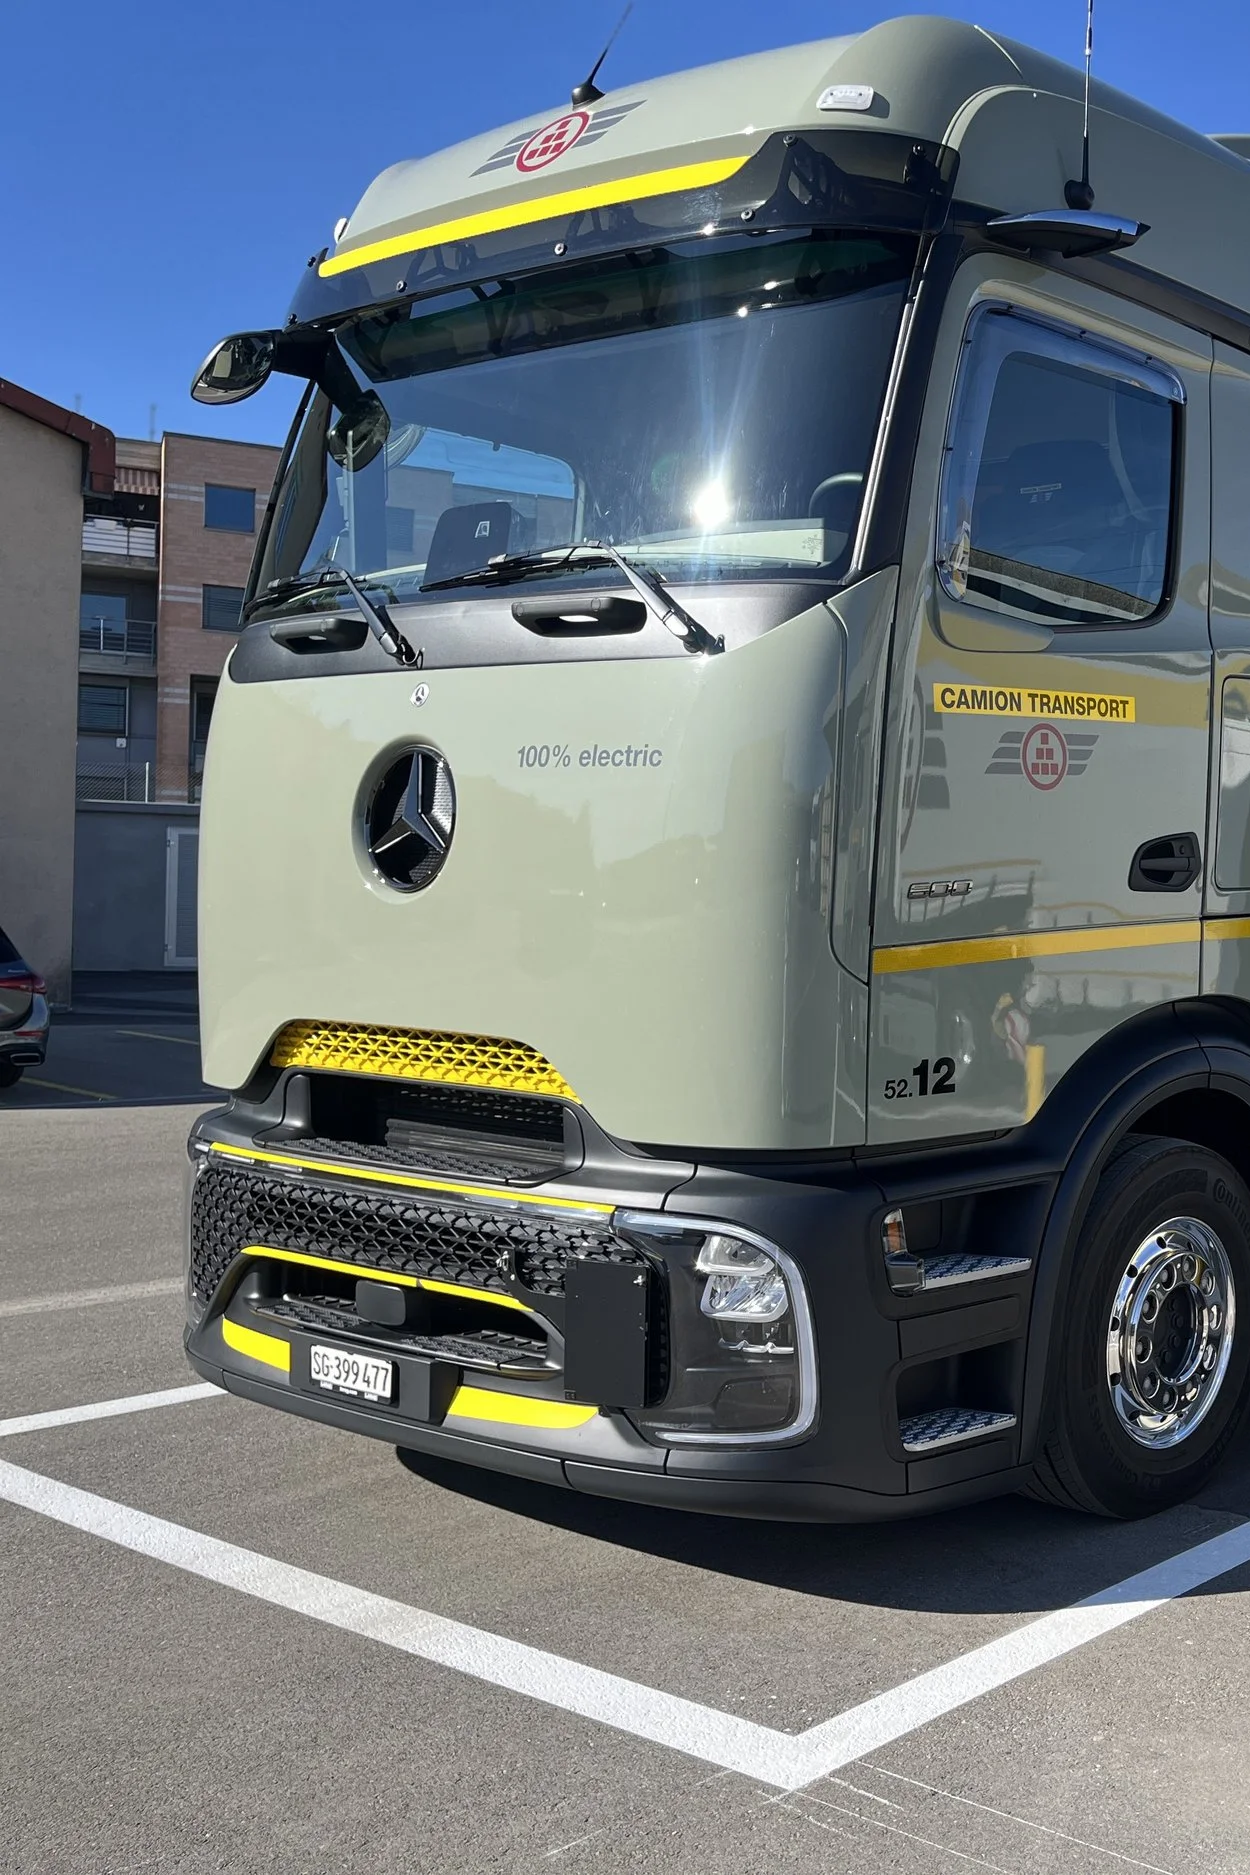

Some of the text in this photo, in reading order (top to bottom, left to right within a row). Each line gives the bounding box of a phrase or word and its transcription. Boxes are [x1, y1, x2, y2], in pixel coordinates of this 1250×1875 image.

[940, 686, 1130, 719] CAMION TRANSPORT
[517, 743, 663, 768] 100% electric
[907, 879, 974, 900] 600
[884, 1056, 956, 1100] 52.12
